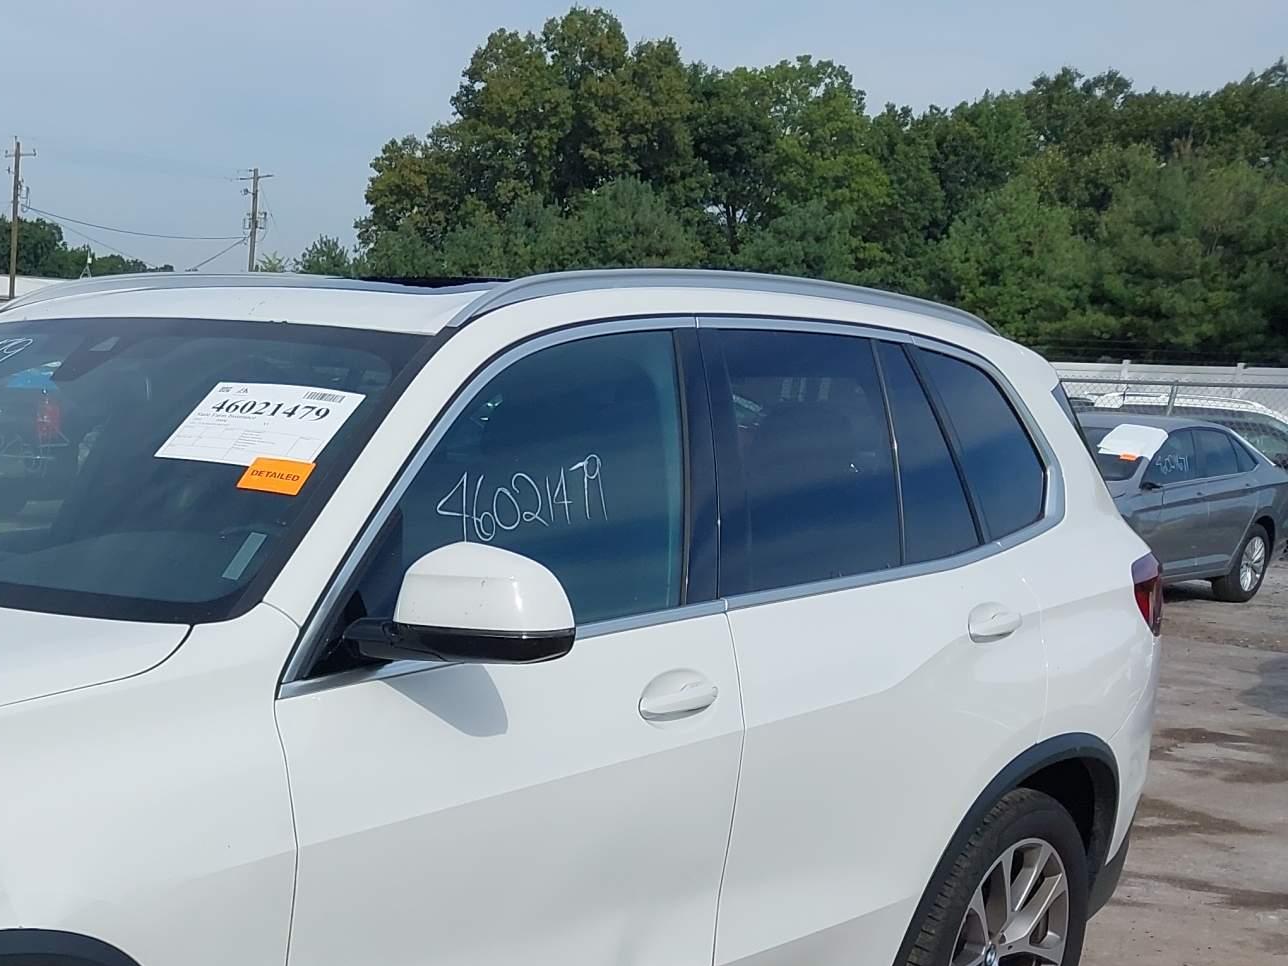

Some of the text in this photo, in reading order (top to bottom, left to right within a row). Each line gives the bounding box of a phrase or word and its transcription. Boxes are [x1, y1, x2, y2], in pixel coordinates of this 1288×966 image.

[211, 398, 331, 422] 46021479
[250, 468, 301, 483] DETAILED
[436, 453, 609, 543] 46021479
